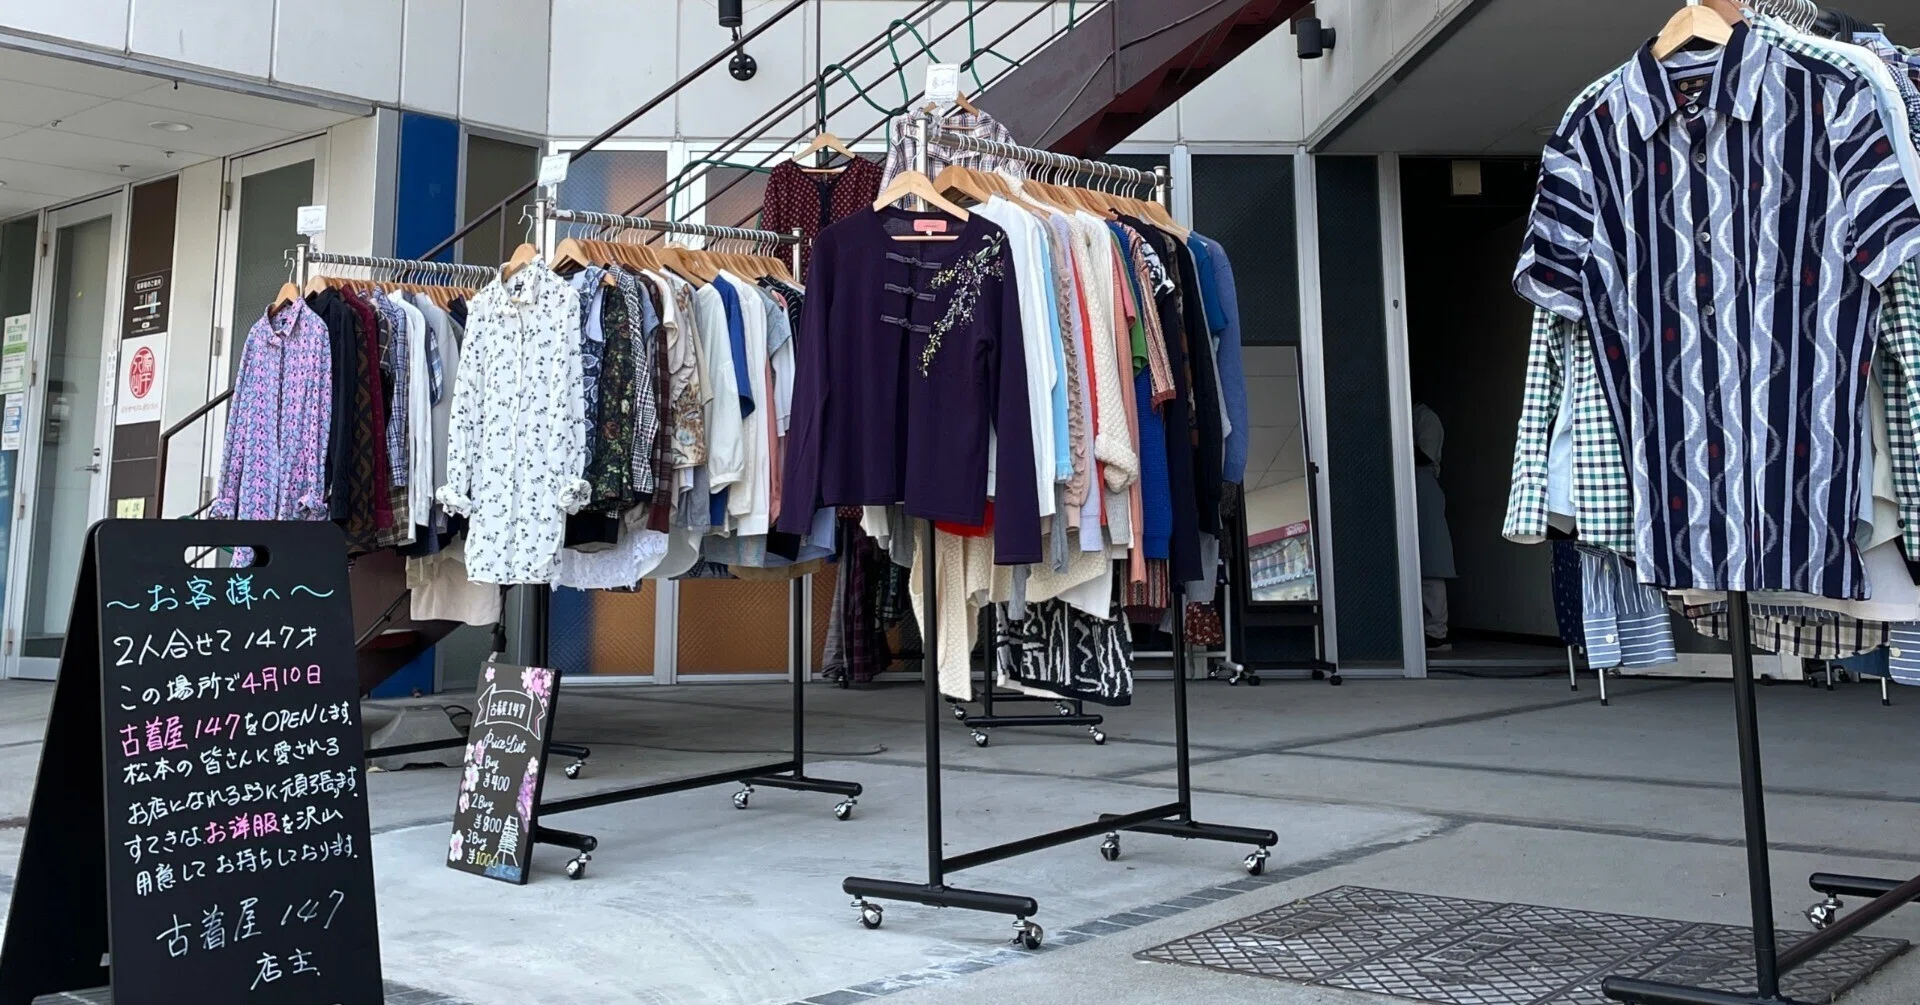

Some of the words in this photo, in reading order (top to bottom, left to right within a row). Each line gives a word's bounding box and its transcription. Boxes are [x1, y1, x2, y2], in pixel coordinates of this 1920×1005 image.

[120, 664, 321, 710] この場所で4月10日
[123, 737, 340, 785] 松本の皆さんに愛される
[483, 728, 507, 749] Price
[505, 734, 527, 753] List
